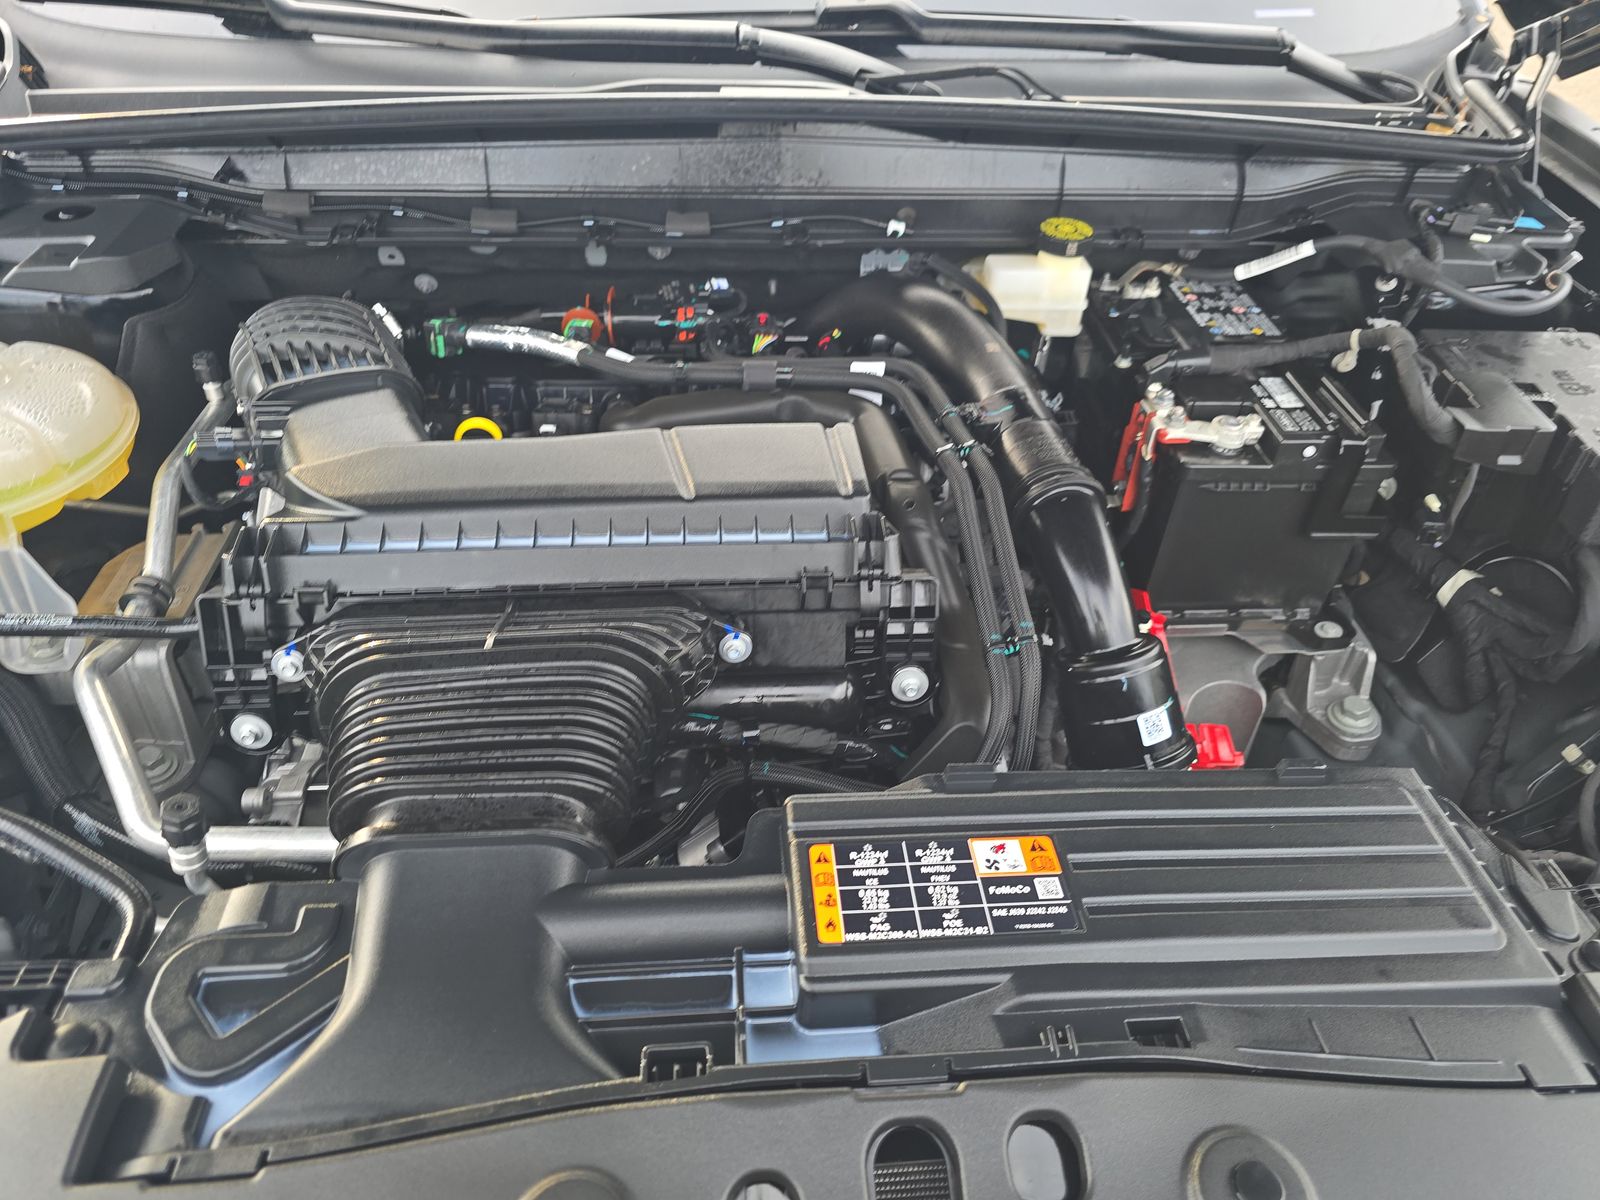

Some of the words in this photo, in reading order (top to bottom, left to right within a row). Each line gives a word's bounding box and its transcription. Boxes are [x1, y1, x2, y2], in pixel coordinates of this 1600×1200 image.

[852, 868, 890, 876] NAUTILUS
[920, 864, 957, 873] NAUTILUS
[878, 888, 890, 898] kg
[946, 886, 960, 894] kg
[988, 884, 1031, 894] FoMoCo
[870, 923, 891, 932] PAG
[942, 918, 964, 928] POE
